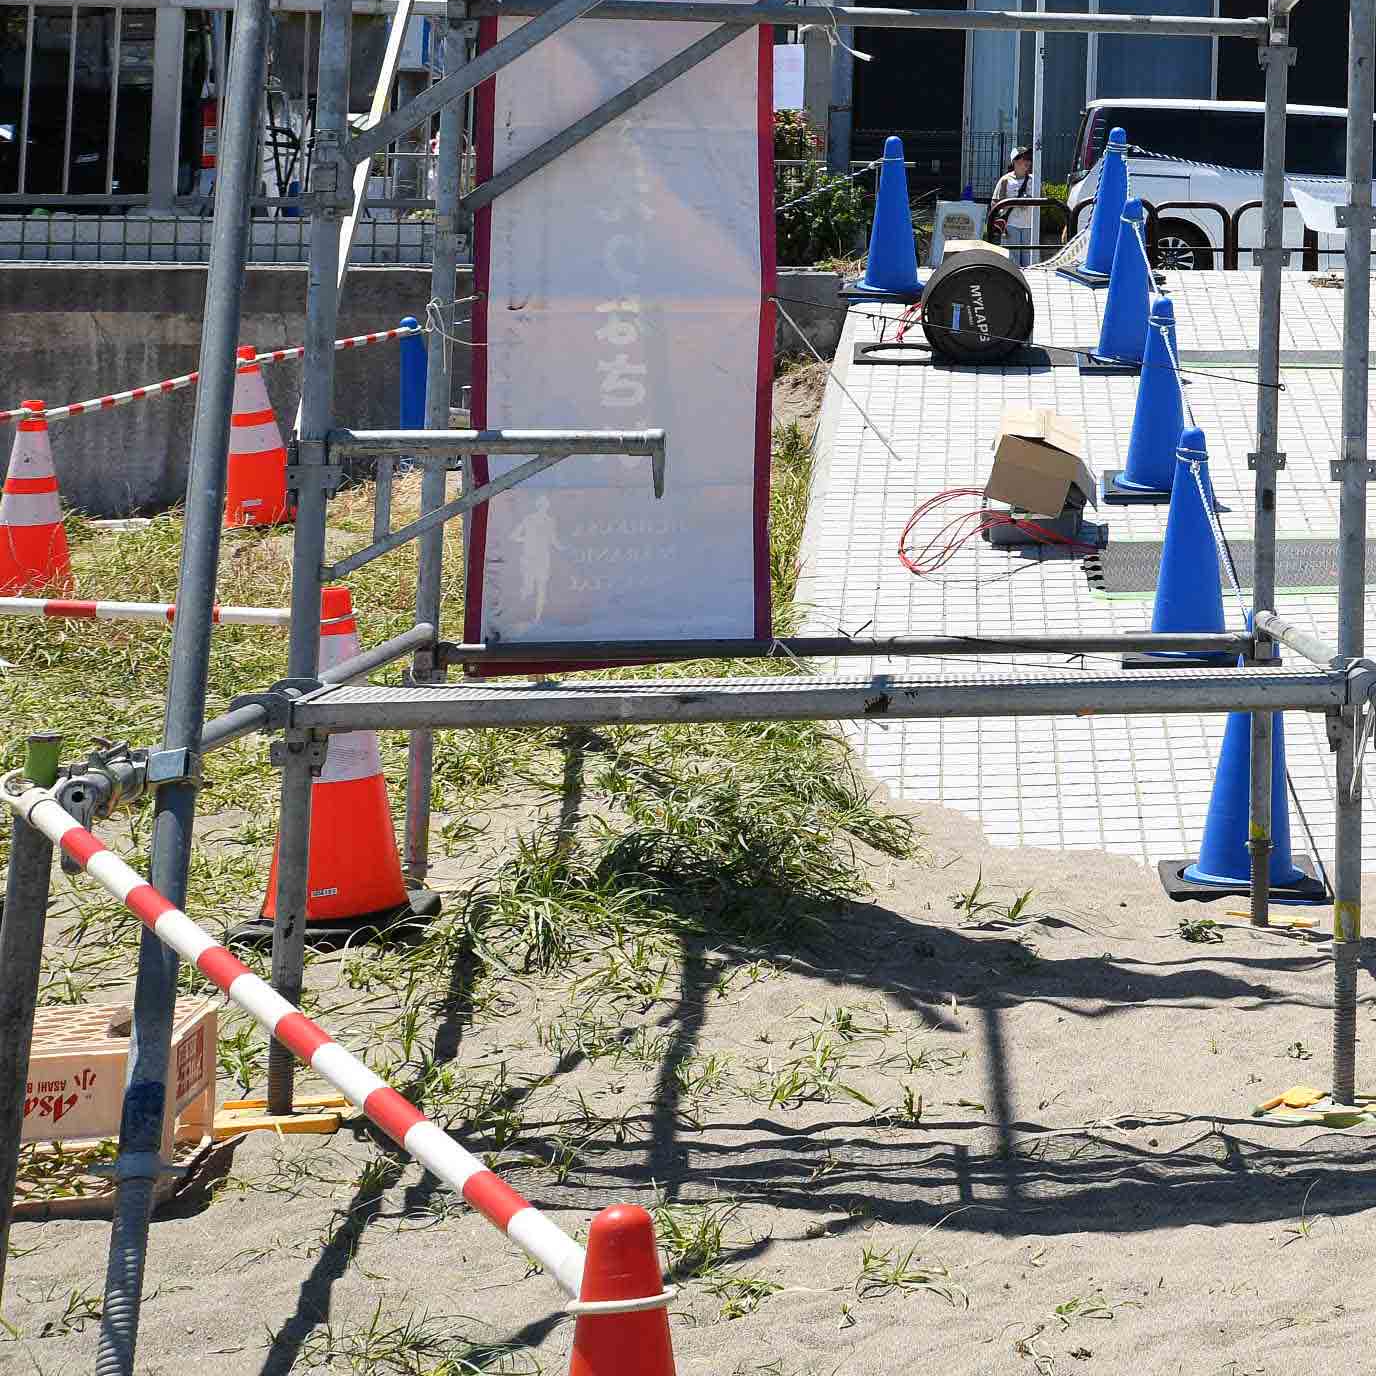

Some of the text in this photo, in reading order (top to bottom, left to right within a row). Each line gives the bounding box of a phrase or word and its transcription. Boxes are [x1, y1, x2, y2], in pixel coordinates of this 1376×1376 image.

[969, 284, 990, 342] MYLAPS
[37, 1080, 67, 1094] ASAHI
[24, 1093, 79, 1124] Asa
